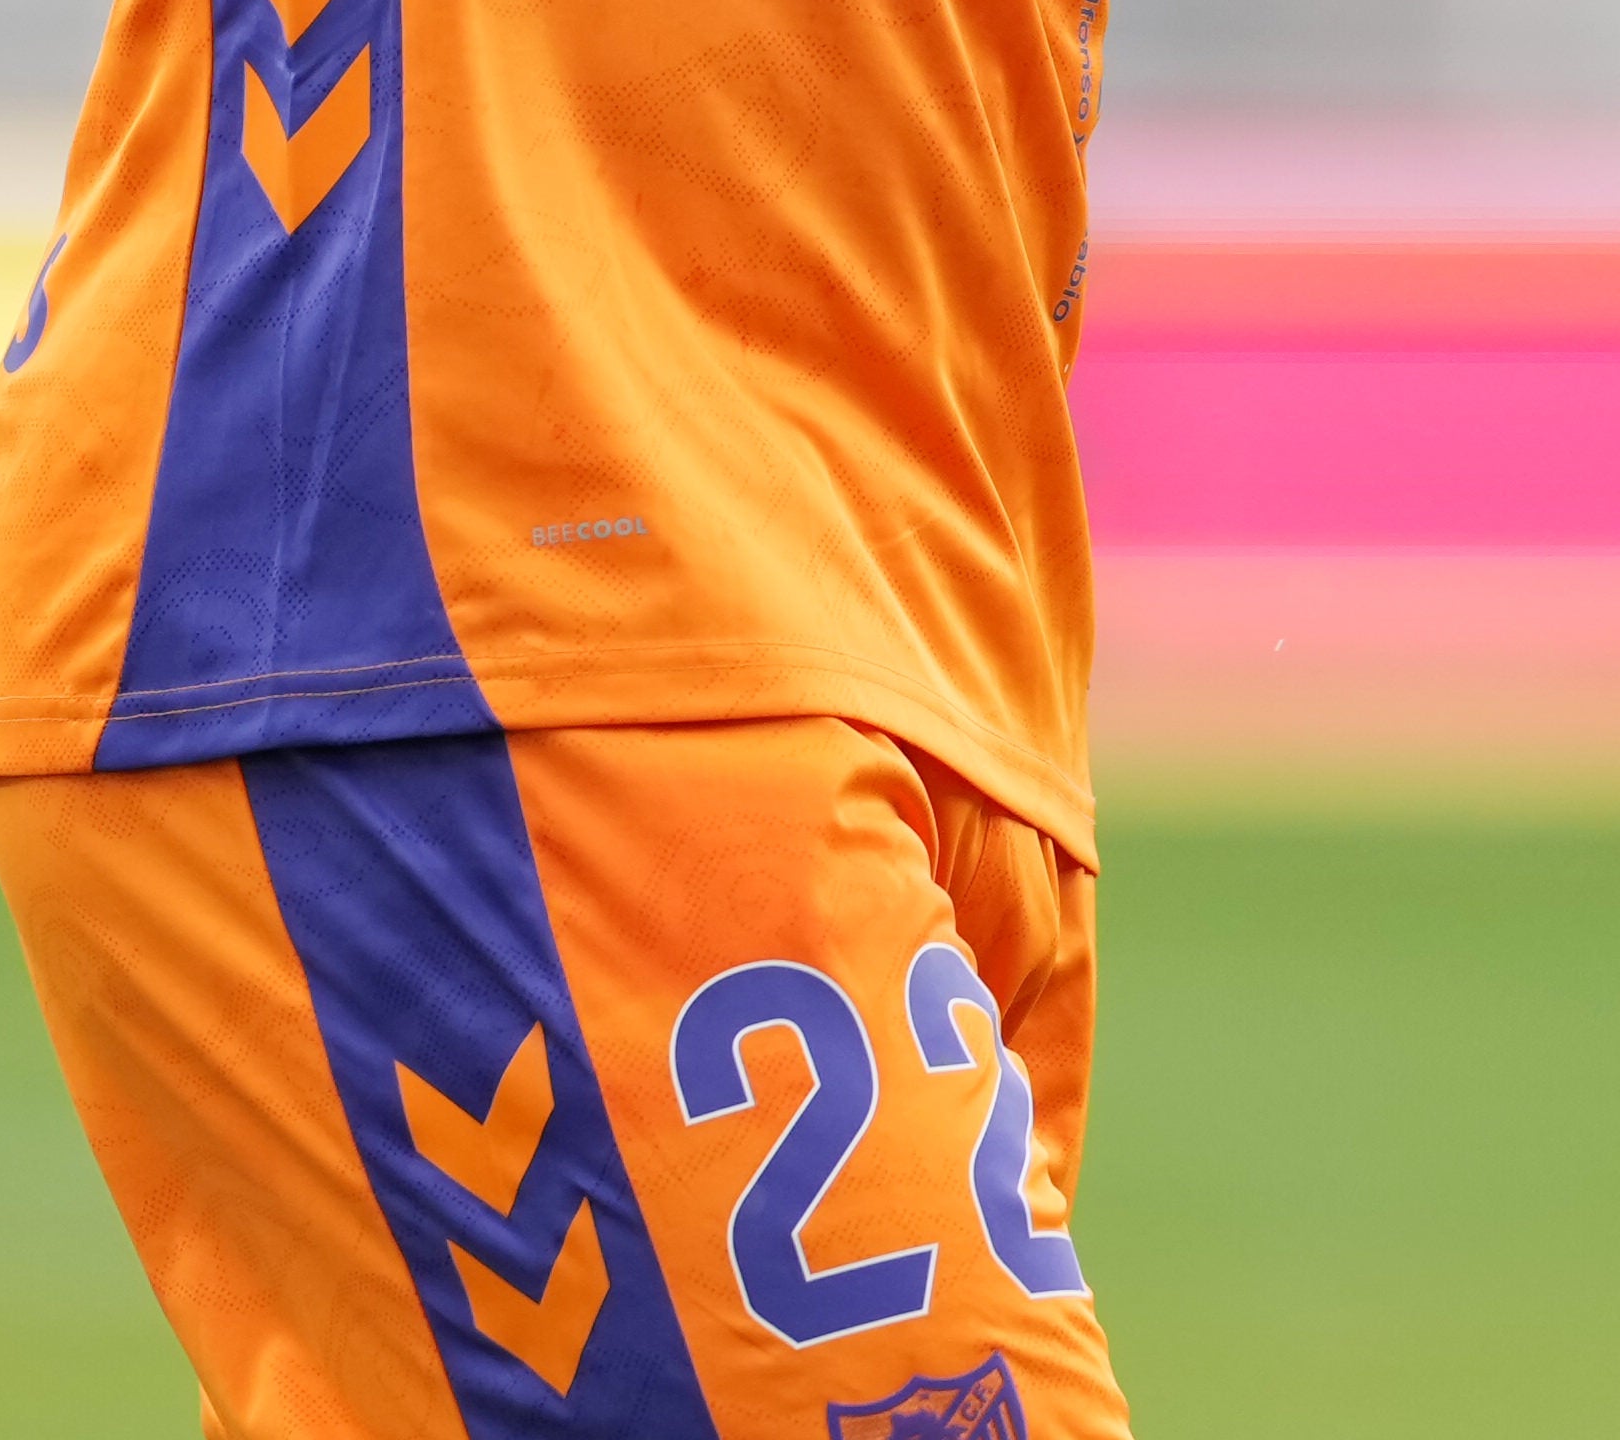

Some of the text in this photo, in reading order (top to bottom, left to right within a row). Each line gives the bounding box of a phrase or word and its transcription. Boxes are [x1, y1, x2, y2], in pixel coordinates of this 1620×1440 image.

[1053, 232, 1089, 323] abio
[532, 517, 649, 547] BEECOOL
[668, 941, 1093, 1350] 22
